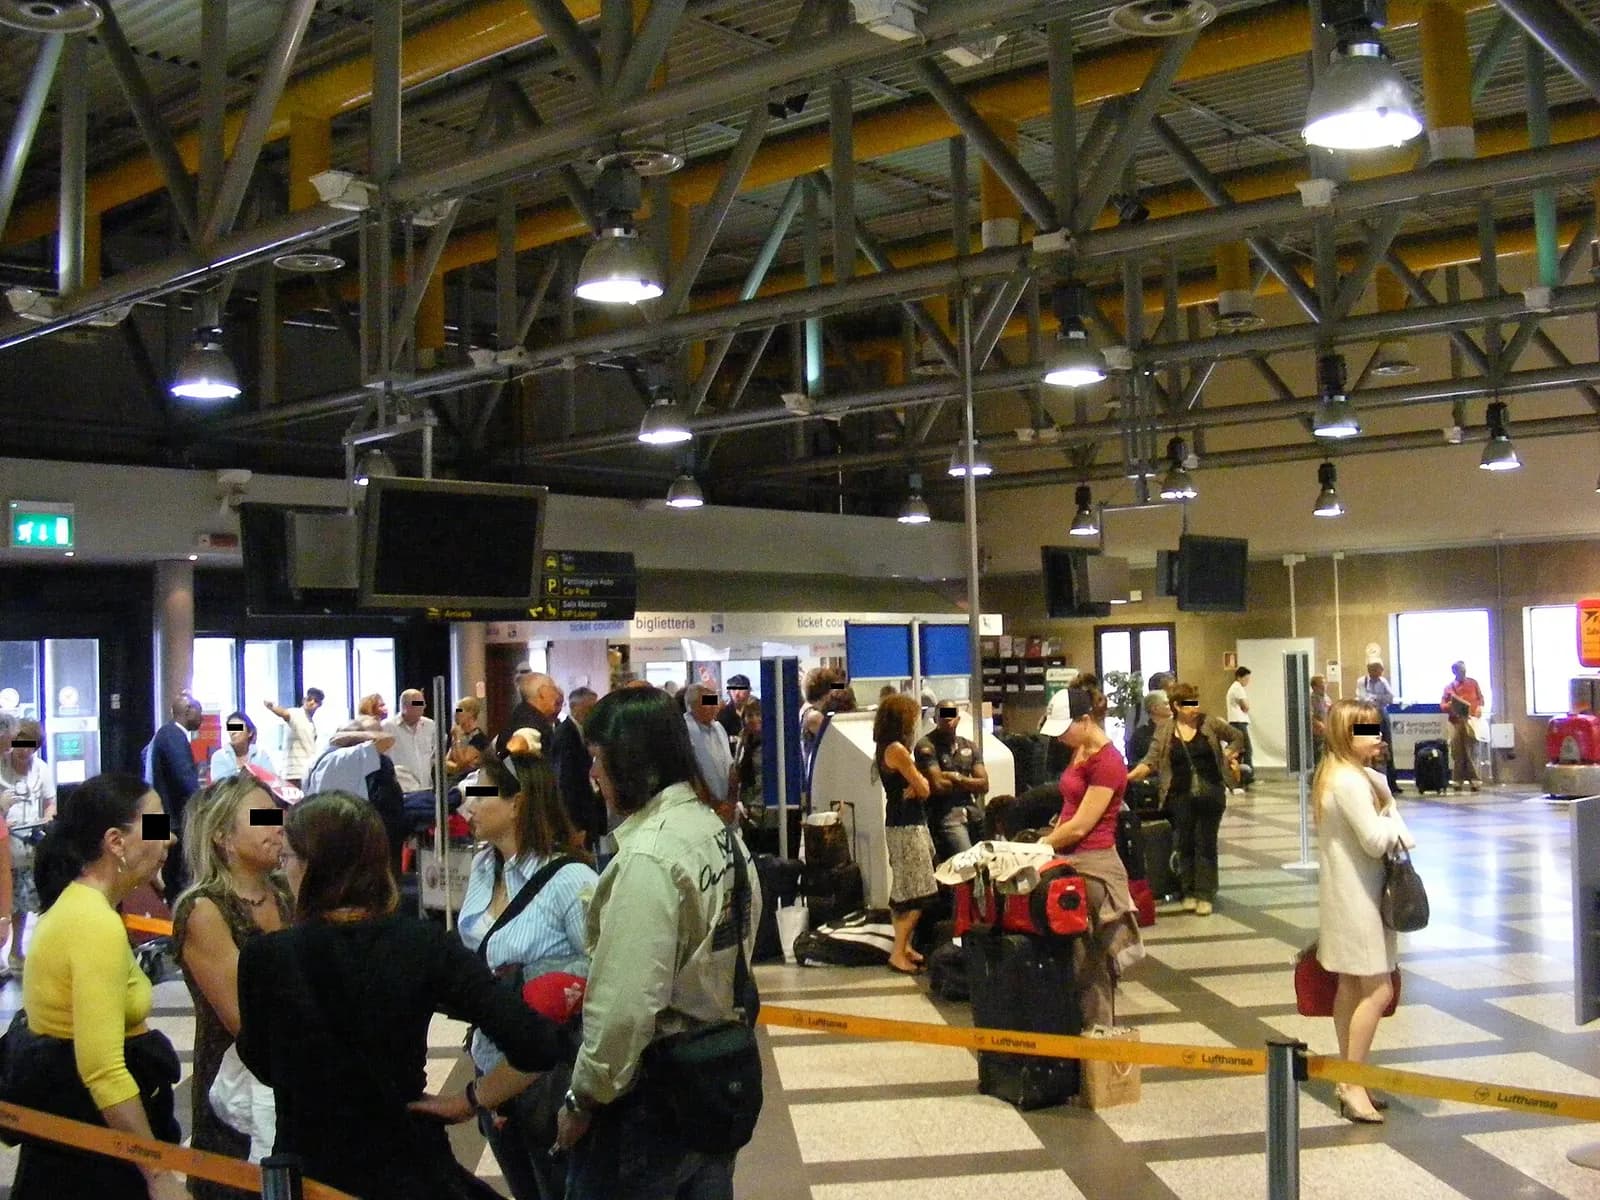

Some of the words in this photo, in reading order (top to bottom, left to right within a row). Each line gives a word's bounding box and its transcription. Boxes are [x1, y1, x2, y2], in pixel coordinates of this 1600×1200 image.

[570, 622, 591, 632] ticket
[593, 621, 624, 631] counter
[635, 616, 696, 632] biglietteria
[796, 617, 824, 628] ticket
[807, 1016, 848, 1029] Lufthansa
[991, 1036, 1036, 1048] Lufthansa
[1201, 1054, 1253, 1066] Lufthansa
[1497, 1092, 1558, 1110] Lufthansa
